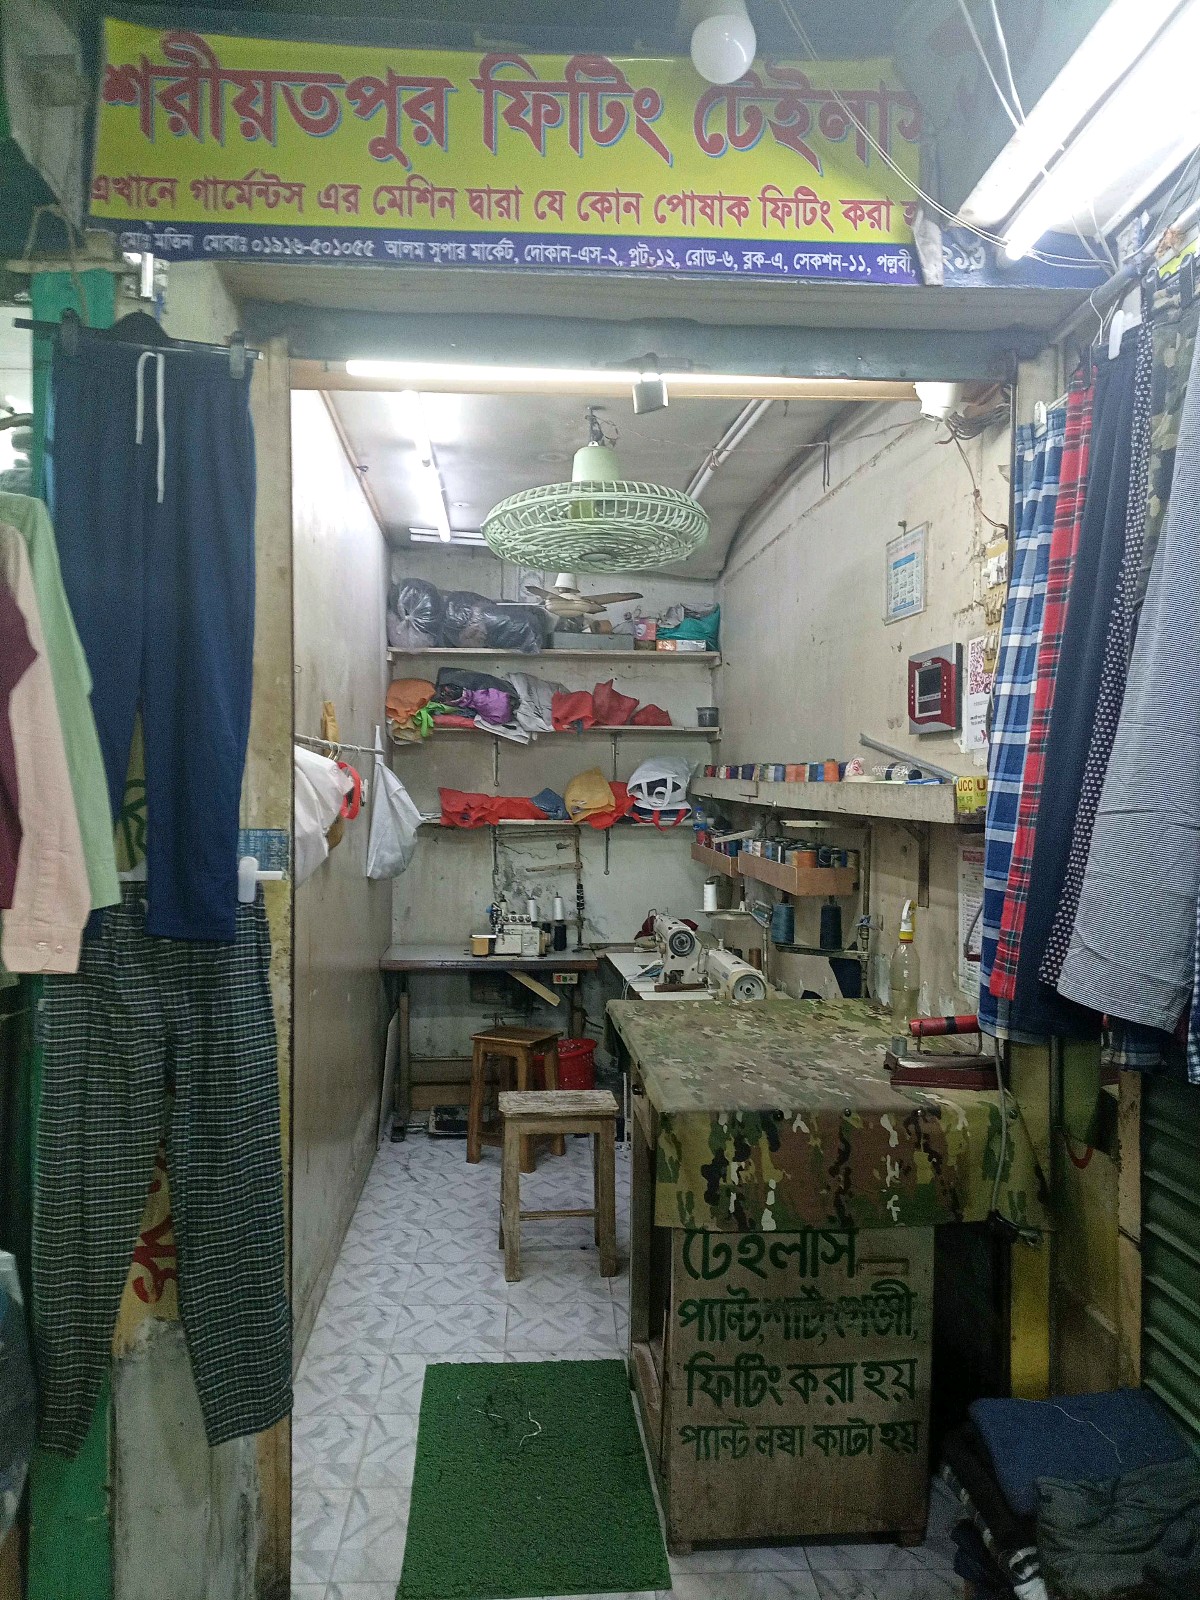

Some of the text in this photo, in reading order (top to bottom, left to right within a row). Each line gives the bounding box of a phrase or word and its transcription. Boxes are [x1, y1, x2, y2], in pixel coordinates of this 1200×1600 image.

[102, 29, 457, 170] শরীয়তপুর
[471, 52, 673, 168] ফিটিং
[90, 174, 177, 207] এখানে
[316, 182, 362, 215] এর
[373, 174, 458, 220] মেশিন
[465, 184, 523, 221] দ্বারা
[534, 189, 566, 222] যে
[577, 187, 644, 224] কোন
[654, 189, 751, 228] পোষাক
[760, 184, 832, 233] ফিটিং
[839, 196, 895, 232] করা
[384, 240, 425, 260] আলম
[429, 242, 465, 263] সুপার
[470, 237, 520, 265] মার্কেট,
[685, 248, 738, 271] রোড-৬,
[793, 251, 872, 276] সেকশন-১১,
[876, 249, 916, 277] পল্লবী,
[684, 1351, 919, 1408] ফিটিং করা হয়
